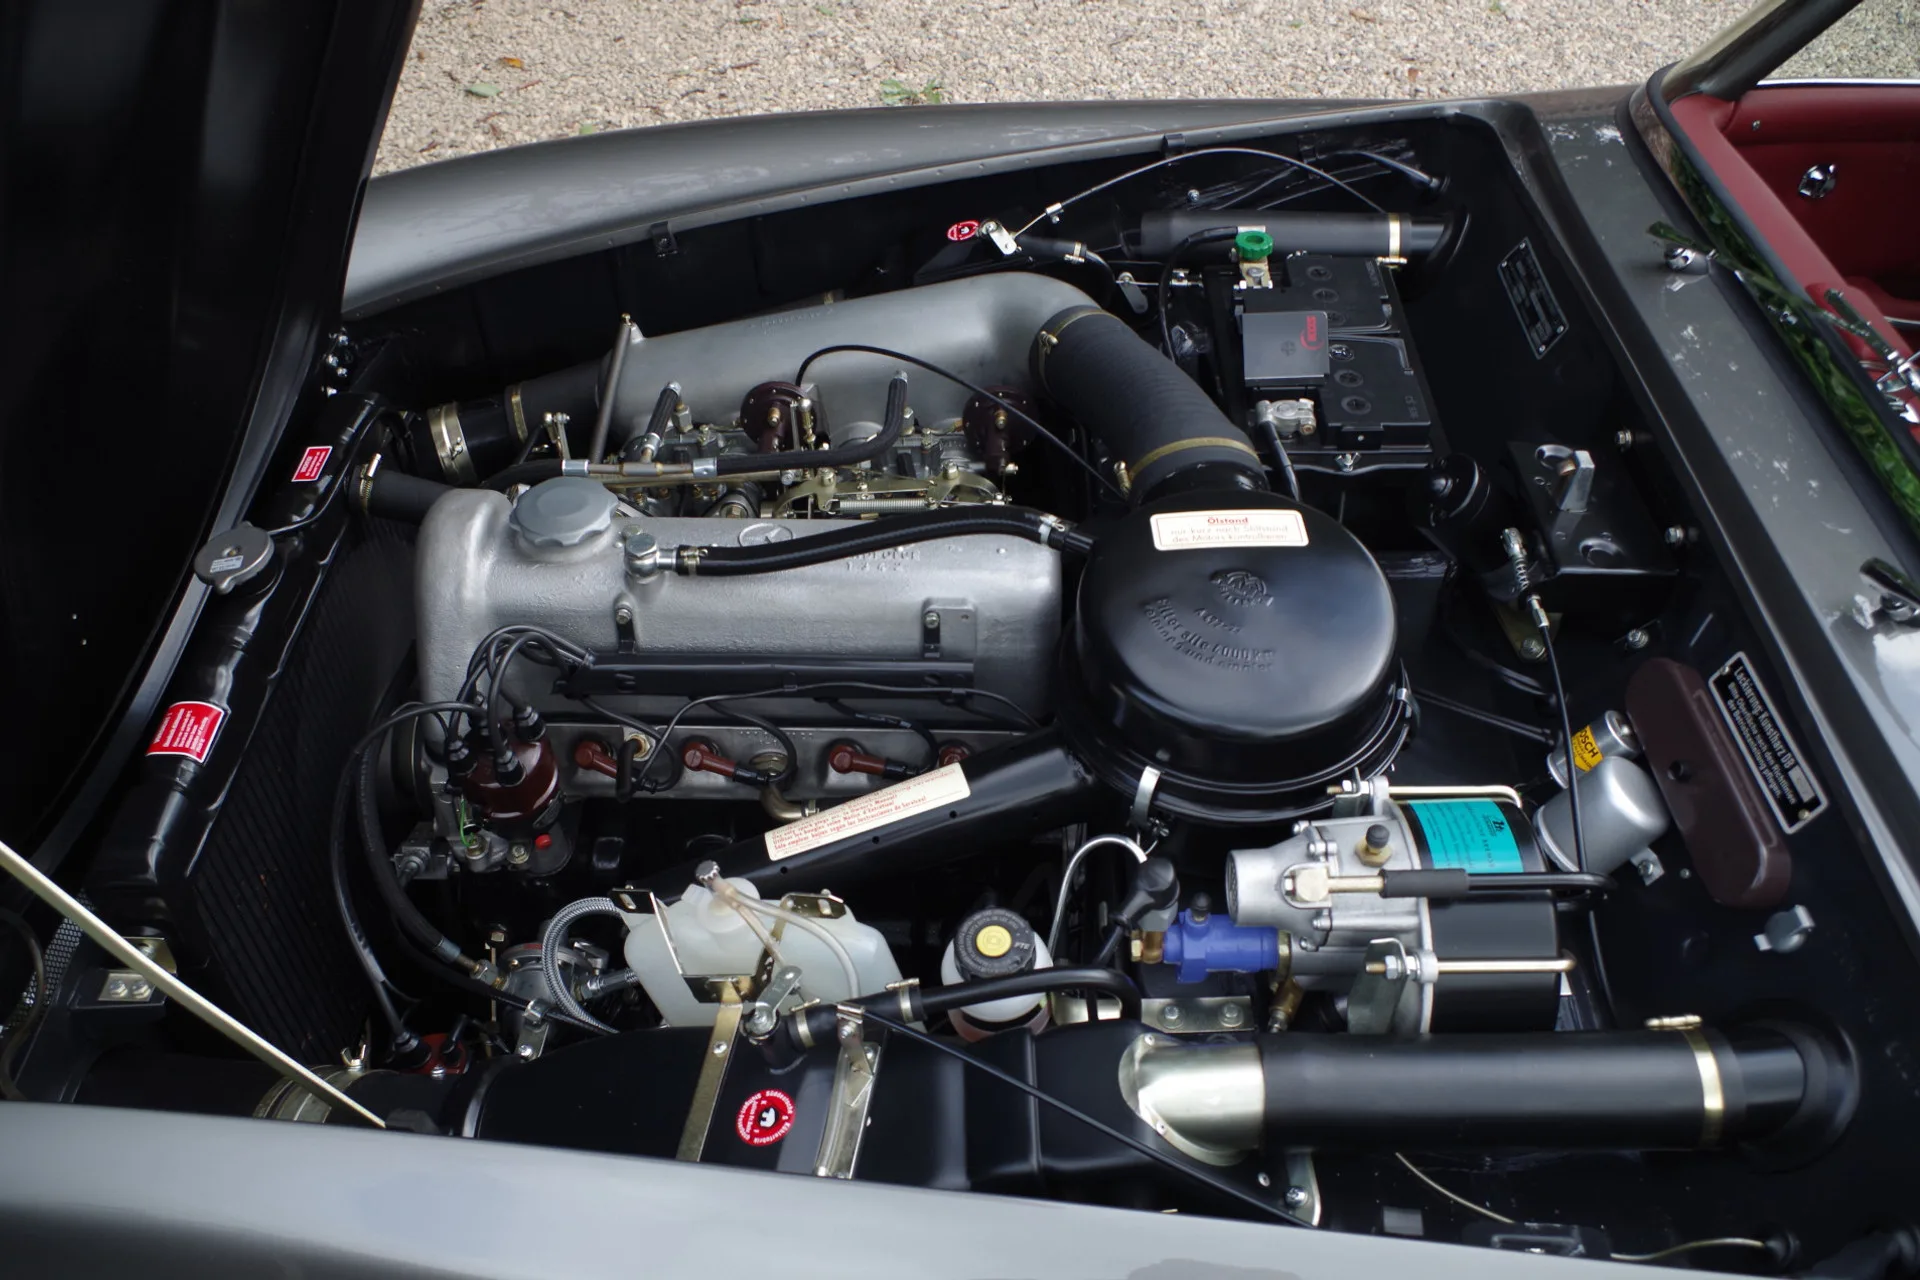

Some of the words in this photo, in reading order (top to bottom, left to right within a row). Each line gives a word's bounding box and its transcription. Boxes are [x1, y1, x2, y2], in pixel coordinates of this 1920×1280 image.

[1180, 630, 1210, 650] alle
[1580, 730, 1599, 758] OSCH
[1731, 710, 1768, 770] Betriebsanleitung
[1732, 666, 1764, 714] Lackierung:
[1757, 712, 1788, 756] Kunstharz
[1780, 753, 1795, 769] DB
[1735, 697, 1759, 734] Oberfläche
[1771, 763, 1797, 804] Richtlinien
